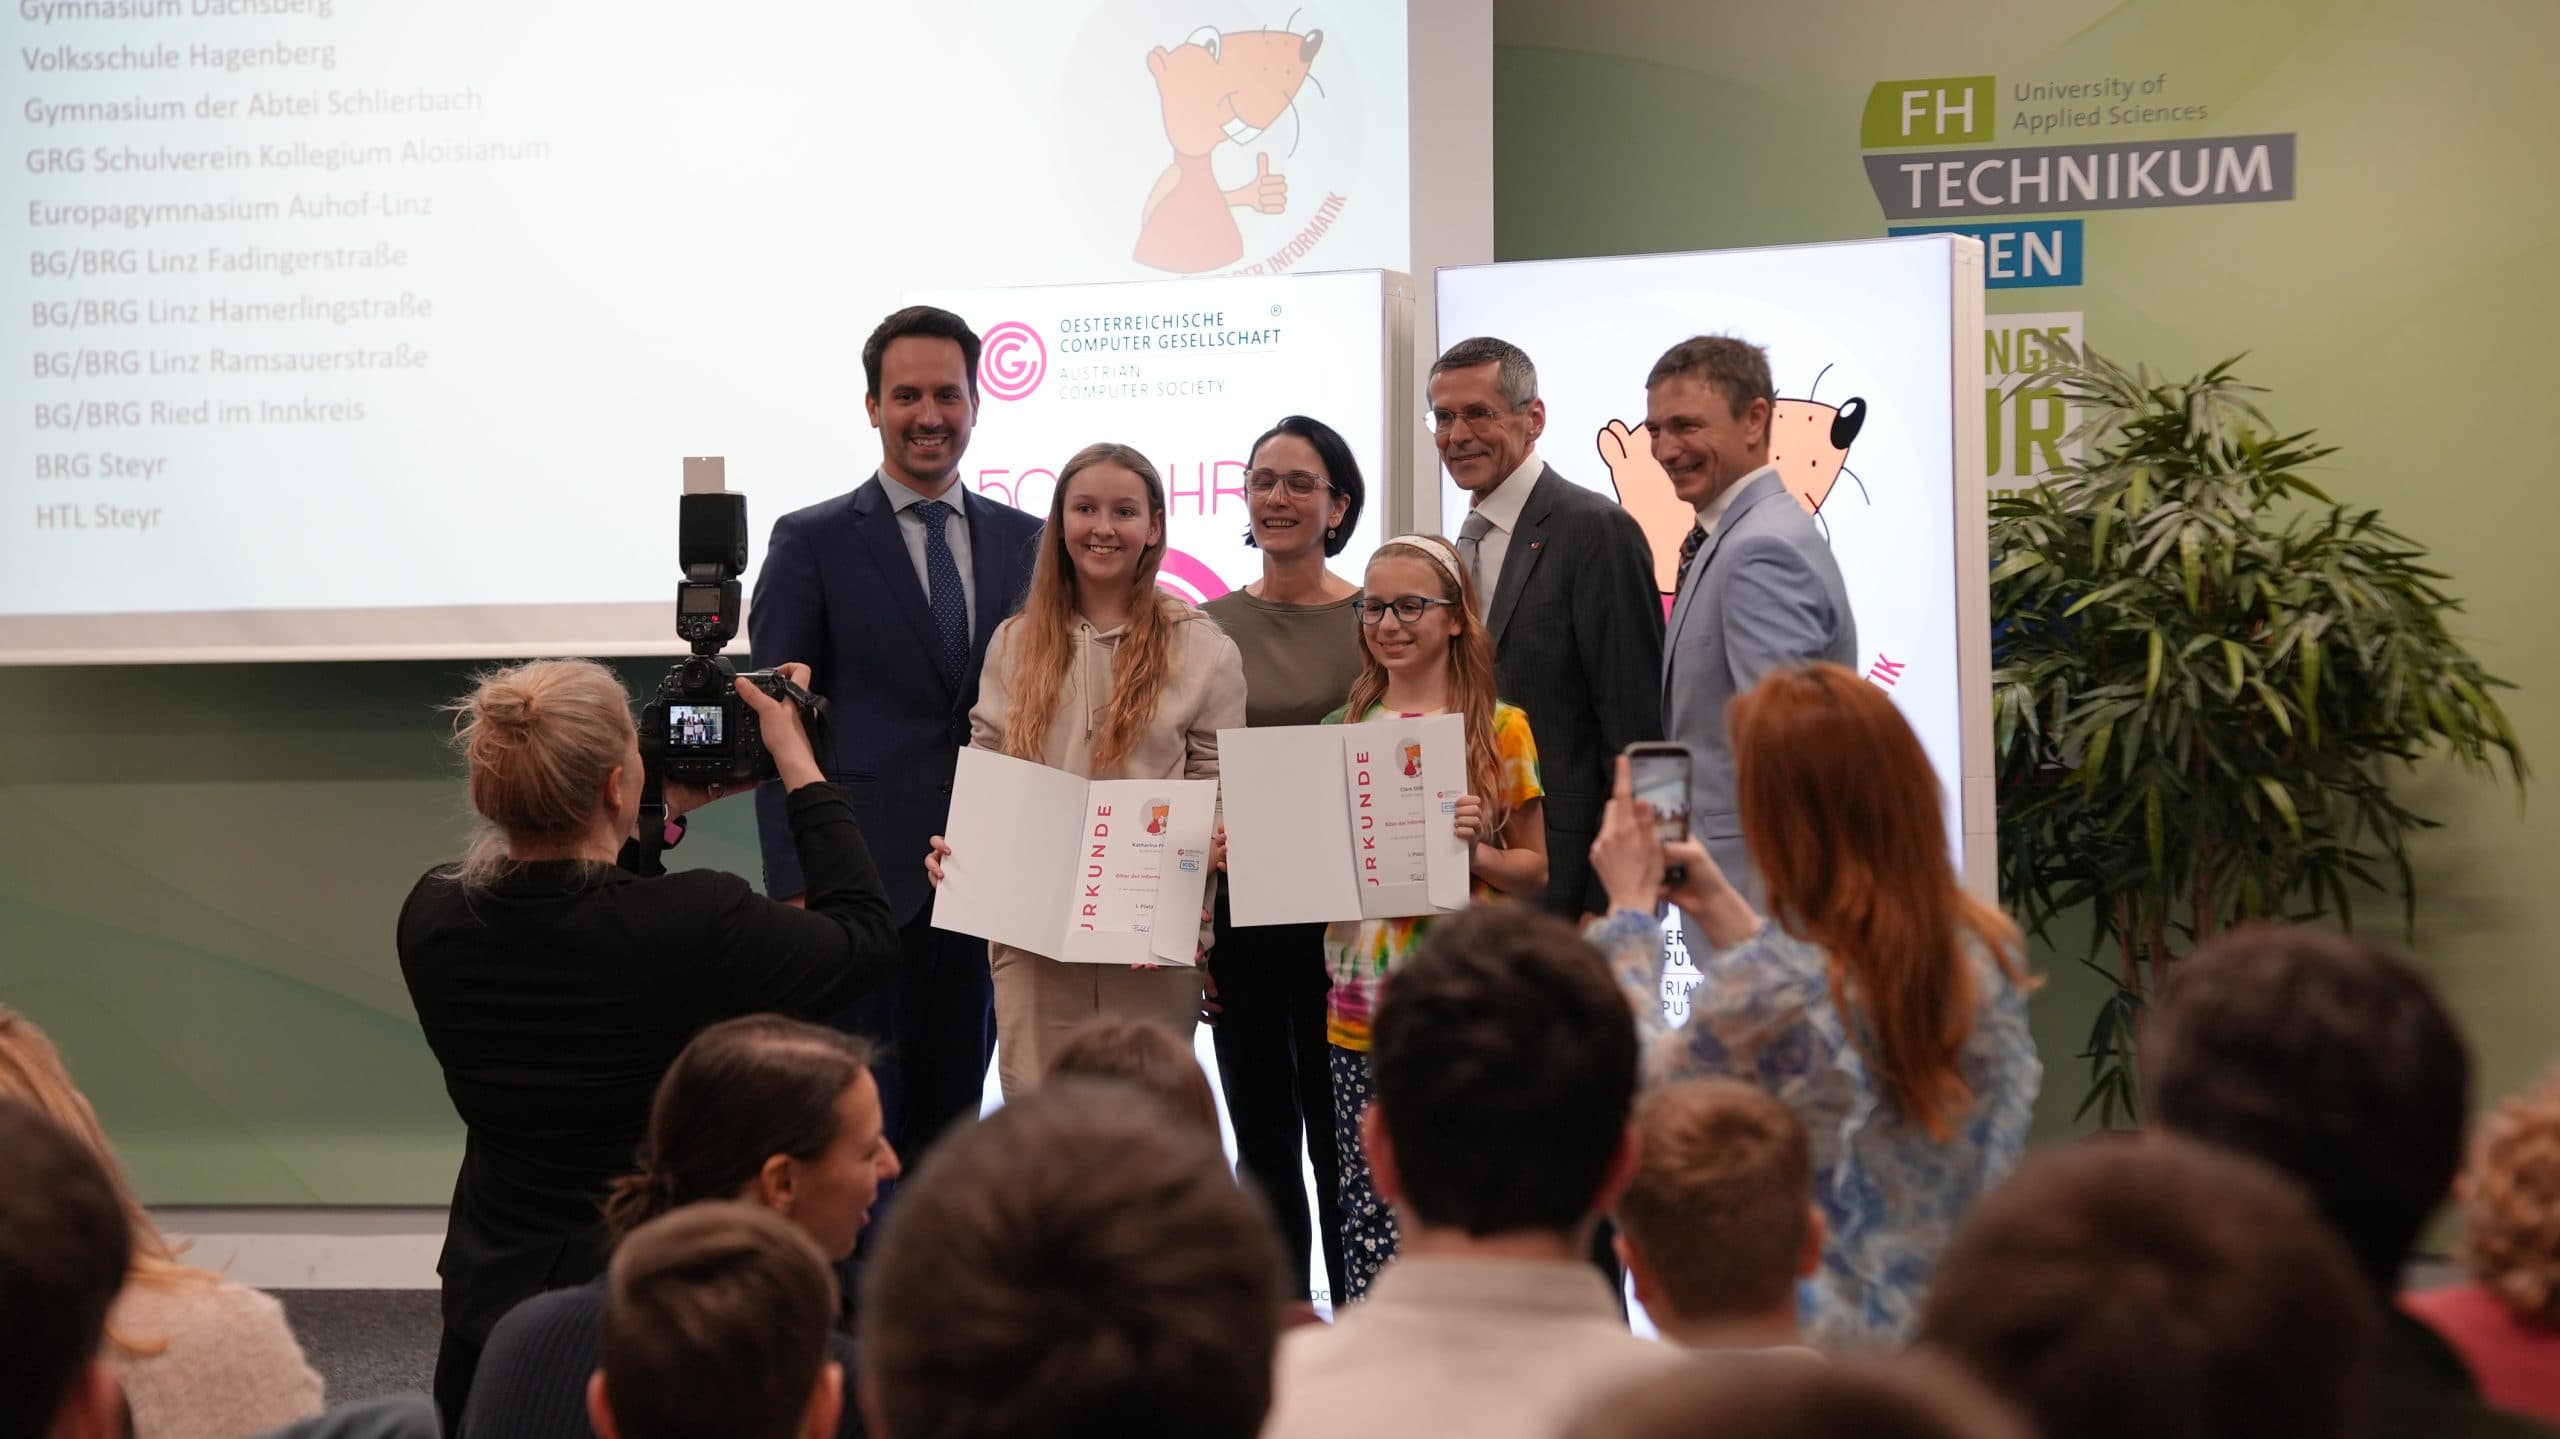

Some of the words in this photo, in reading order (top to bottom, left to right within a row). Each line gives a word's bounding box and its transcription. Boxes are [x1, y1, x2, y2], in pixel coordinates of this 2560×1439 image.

[19, 0, 182, 25] Gymnasium
[21, 43, 180, 72] Volksschule
[189, 40, 336, 72] Hagenberg
[24, 95, 185, 128] Gymnasium
[195, 92, 239, 120] der
[247, 90, 319, 117] Abtei
[327, 86, 482, 116] Schlierbach
[2013, 76, 2135, 109] University
[2139, 73, 2167, 96] of
[1900, 86, 1974, 137] FH
[2012, 104, 2100, 136] Applied
[2108, 102, 2208, 126] Sciences
[26, 148, 85, 174] GRG
[93, 145, 250, 173] Schulverein
[259, 141, 391, 172] Kollegium
[400, 136, 551, 165] Aloisianum
[1900, 144, 2274, 209] TECHNIKUM
[28, 198, 279, 229] Europagymnasium
[288, 191, 432, 219] Auhof-Linz
[1266, 191, 1347, 273] INFORMATIK
[30, 248, 137, 279] BG/BRG
[147, 248, 198, 275] Linz
[208, 242, 407, 275] Fadingerstraße
[1988, 230, 2063, 279] EN
[32, 299, 139, 330] BG/BRG
[148, 298, 199, 325] Linz
[209, 291, 432, 325] Hamerlingstraße
[1060, 312, 1224, 333] OESTERREICHISCHE
[1060, 335, 1151, 353] COMPUTER
[1158, 329, 1281, 350] GESELLSCHAFT
[33, 349, 140, 380] BG/BRG
[149, 348, 200, 375] Linz
[210, 343, 428, 374] Ramsauerstraße
[1059, 364, 1141, 380] AUSTRIAN
[1059, 383, 1149, 400] COMPUTER
[1157, 379, 1225, 397] SOCIETY
[35, 400, 141, 432] BG/BRG
[150, 399, 208, 425] Ried
[218, 399, 251, 424] im
[261, 396, 365, 423] Innkreis
[36, 452, 91, 479] BRG
[99, 451, 167, 481] Steyr
[36, 503, 87, 529] HTL
[95, 502, 162, 531] Steyr
